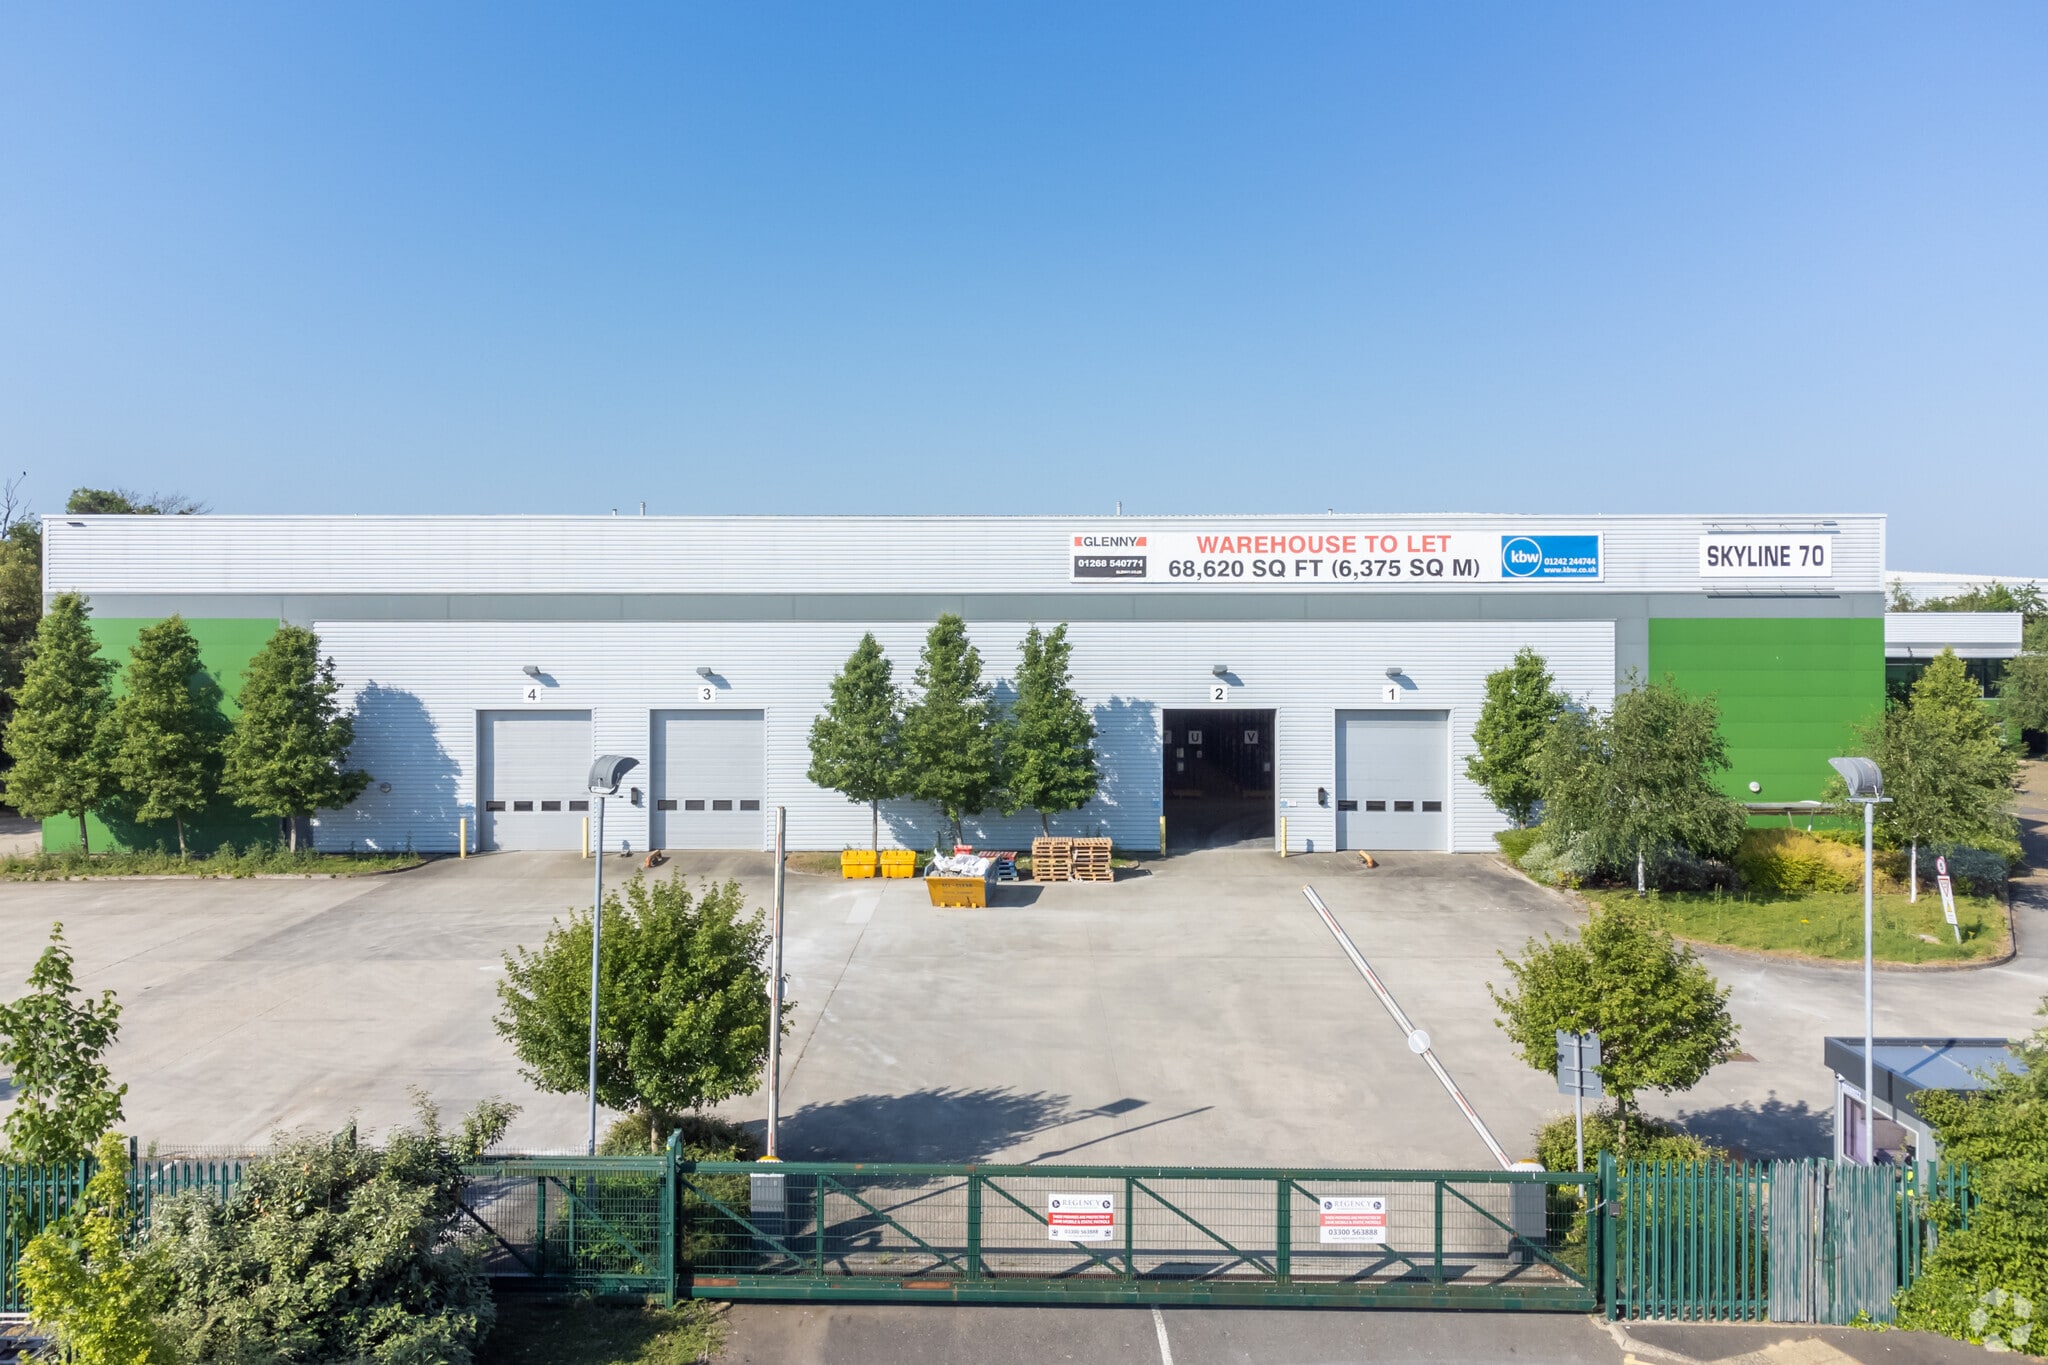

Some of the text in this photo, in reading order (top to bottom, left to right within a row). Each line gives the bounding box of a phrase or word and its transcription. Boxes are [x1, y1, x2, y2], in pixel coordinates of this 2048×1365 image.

[1083, 536, 1137, 547] GLENNY
[1196, 535, 1451, 554] WAREHOUSE TO LET
[1511, 549, 1539, 563] kbw
[1544, 557, 1596, 565] 01242 244744
[1707, 545, 1824, 567] SKYLINE 70
[1078, 559, 1143, 568] 01268 540771
[1168, 558, 1480, 580] 68,620 SQ FT (6,375 SQ M)
[527, 688, 537, 700] 4
[703, 688, 711, 700] 3
[1215, 688, 1223, 700] 2
[1388, 688, 1395, 700] 1
[1191, 732, 1200, 742] U
[1247, 732, 1256, 742] V
